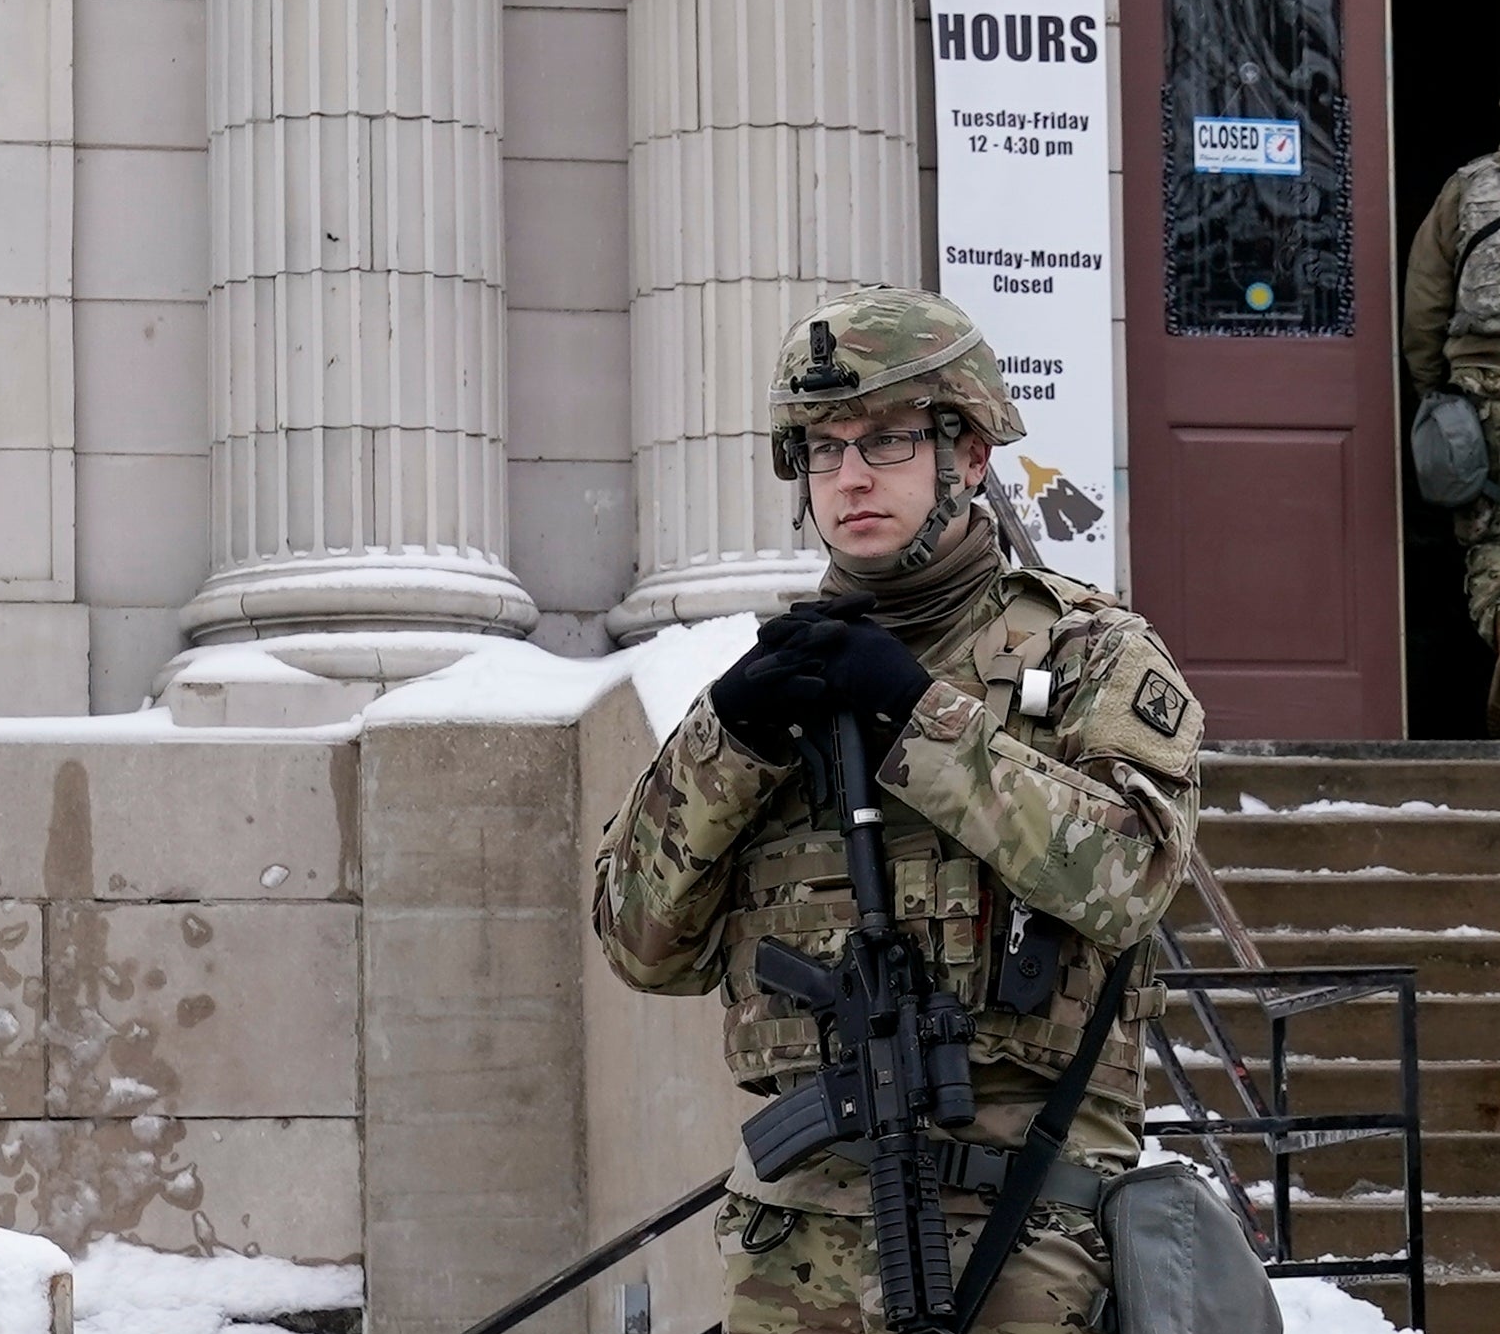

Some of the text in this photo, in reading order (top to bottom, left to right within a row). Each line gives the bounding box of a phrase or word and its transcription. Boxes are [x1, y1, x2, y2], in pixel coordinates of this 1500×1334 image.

[938, 13, 1098, 64] HOURS
[952, 109, 1089, 132] Tuesday-Friday
[969, 134, 988, 153] 12
[1004, 136, 1040, 155] 4:30
[1046, 140, 1073, 157] pm
[1199, 124, 1259, 150] CLOSED
[946, 246, 1102, 270] Saturday-Monday
[993, 275, 1054, 294] Closed
[997, 357, 1064, 375] olidays
[1008, 383, 1056, 400] osed
